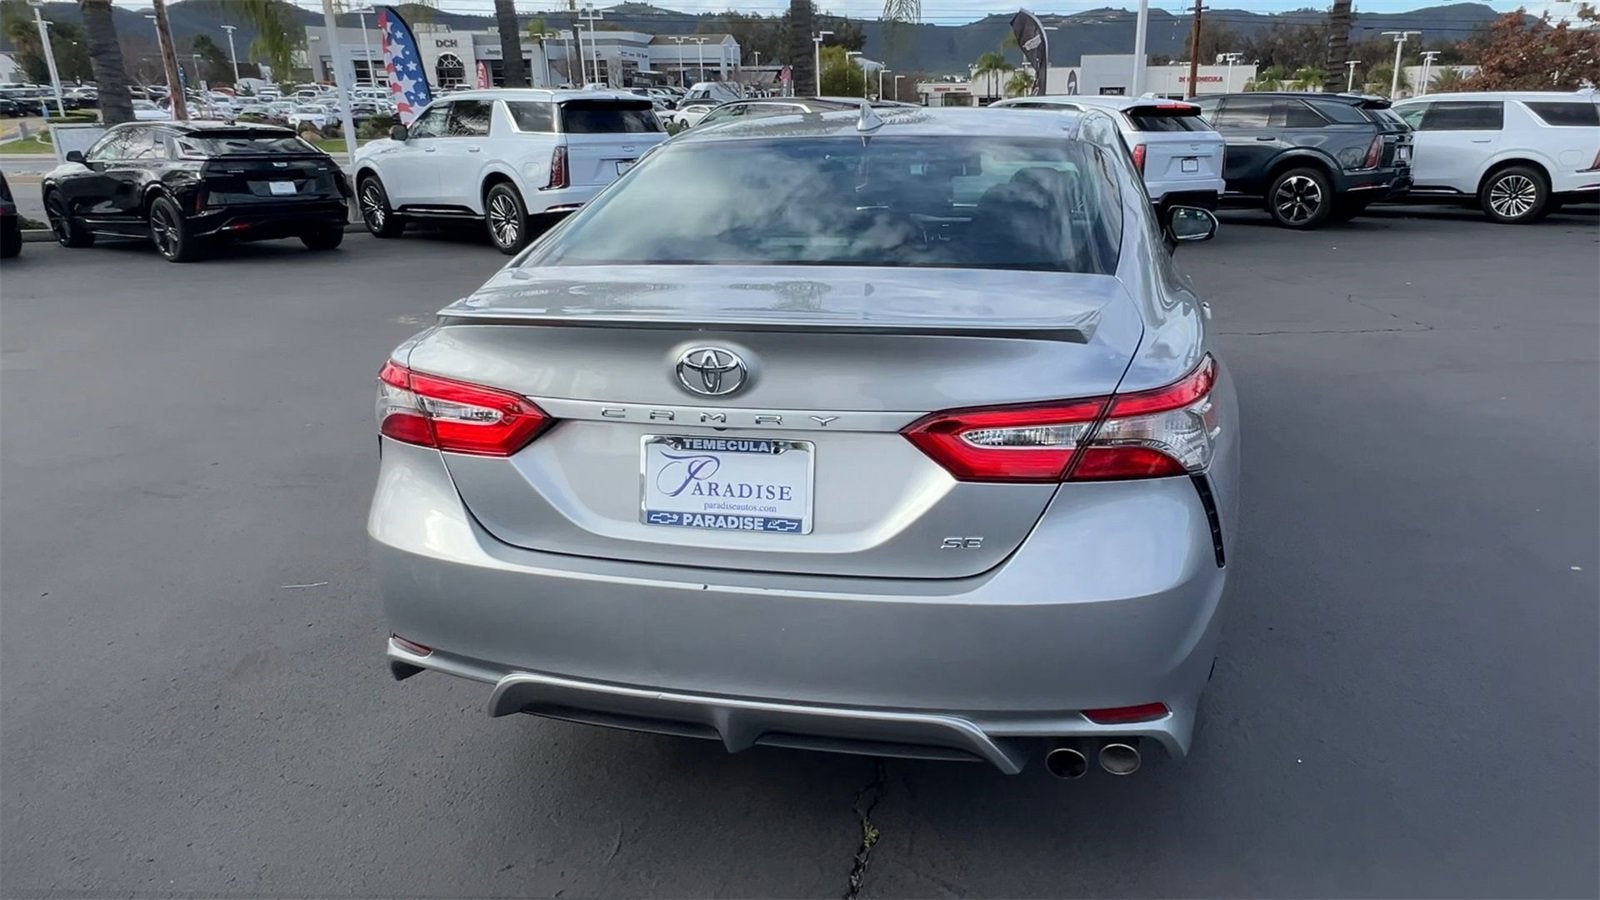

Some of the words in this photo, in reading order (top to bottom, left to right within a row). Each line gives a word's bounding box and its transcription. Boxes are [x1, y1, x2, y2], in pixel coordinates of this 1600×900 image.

[435, 39, 458, 48] DCH
[601, 407, 840, 426] CAMRY
[682, 438, 769, 453] TEMECULA
[703, 501, 778, 513] paradiseautos.com
[682, 513, 765, 531] PARADISE
[940, 536, 984, 550] SE
